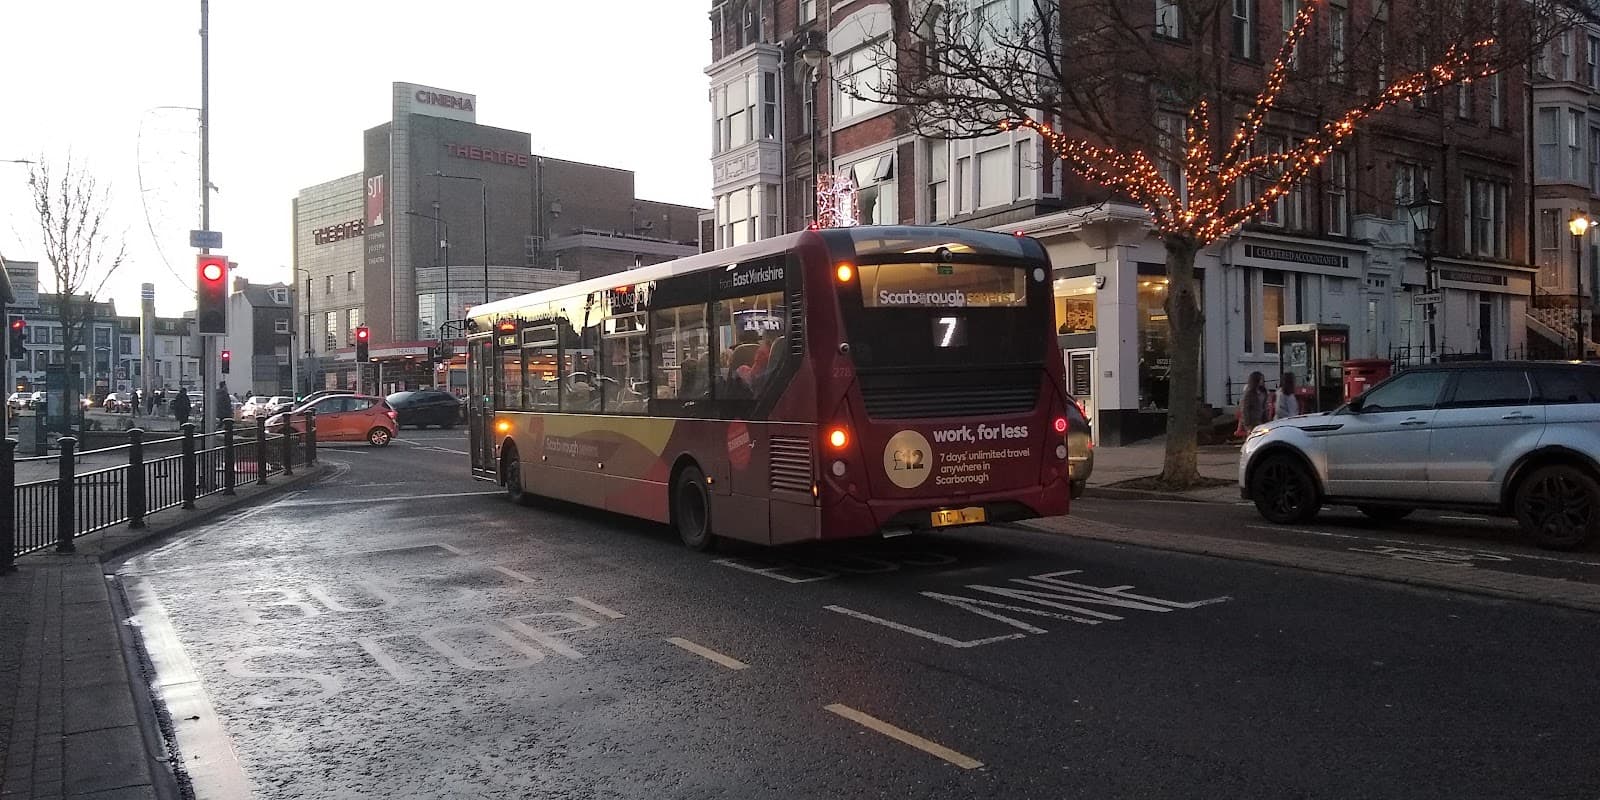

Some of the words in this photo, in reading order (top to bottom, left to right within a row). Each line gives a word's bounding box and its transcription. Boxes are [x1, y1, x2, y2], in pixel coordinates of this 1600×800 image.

[415, 90, 474, 112] CINEMA
[444, 143, 529, 168] THEATRE
[367, 175, 384, 198] SJT
[1256, 247, 1294, 260] CHARTERED
[1295, 252, 1338, 266] ACCOUNTANTS
[879, 289, 965, 308] Scarborough
[938, 317, 957, 347] 7
[933, 427, 975, 443] work,
[977, 424, 1001, 440] for
[1002, 423, 1029, 439] less
[893, 449, 924, 471] £12
[940, 453, 945, 462] 7
[969, 449, 1006, 460] unlimited
[1007, 447, 1030, 458] travel
[941, 463, 980, 474] anywhere
[981, 462, 991, 471] in
[936, 473, 990, 486] Scarborough
[823, 569, 1234, 648] LANE
[225, 612, 601, 706] STOP
